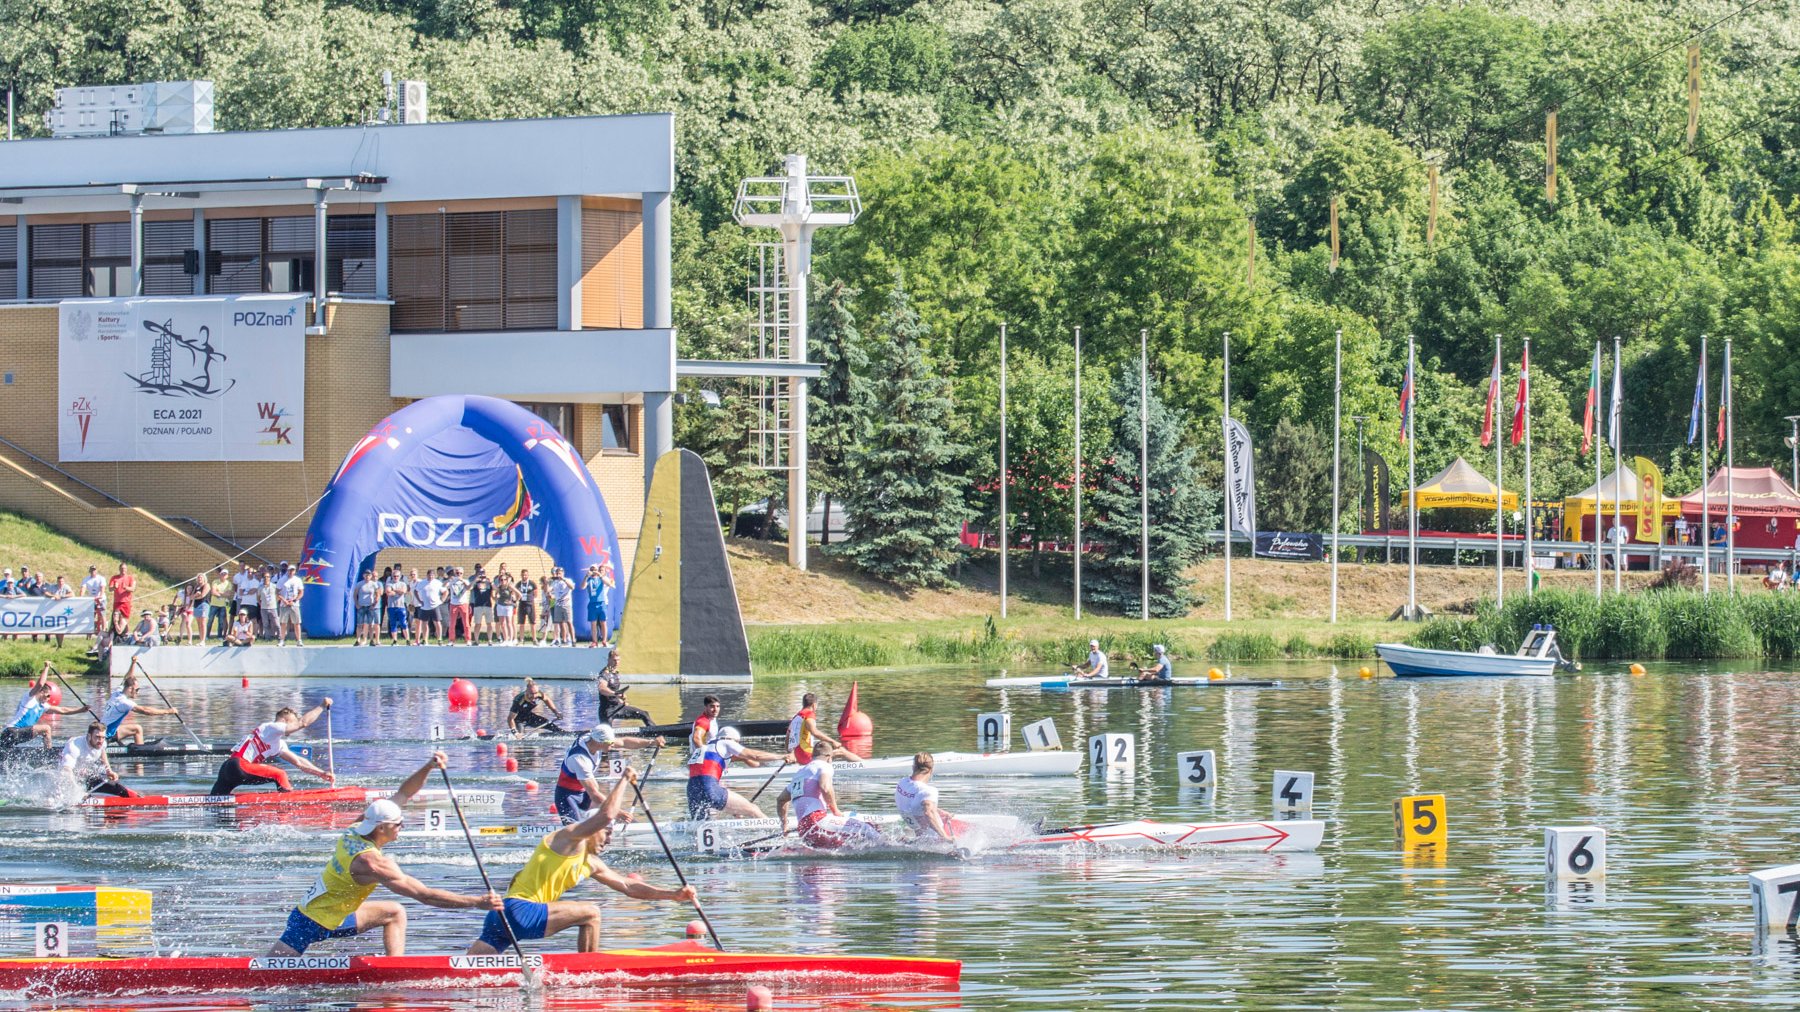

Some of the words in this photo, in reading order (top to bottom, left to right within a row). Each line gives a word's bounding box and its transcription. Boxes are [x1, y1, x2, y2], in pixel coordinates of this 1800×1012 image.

[153, 409, 176, 420] ECA
[179, 408, 202, 420] 2021
[142, 427, 175, 436] POZNAN
[181, 427, 213, 436] POLAND
[434, 726, 439, 736] 1
[1036, 725, 1050, 747] 1
[1094, 739, 1104, 765] 2
[1114, 738, 1127, 763] 2
[613, 760, 623, 774] 3
[1186, 755, 1207, 784] 3
[1280, 776, 1303, 808] 4
[430, 810, 440, 827] 5
[1413, 799, 1438, 836] 5
[703, 828, 715, 848] 6
[1568, 835, 1595, 875] 6
[1776, 880, 1800, 929] 7
[43, 924, 59, 951] 8
[267, 958, 349, 969] RYBACHOK
[450, 957, 463, 968] V.
[466, 955, 542, 967] VERHELES
